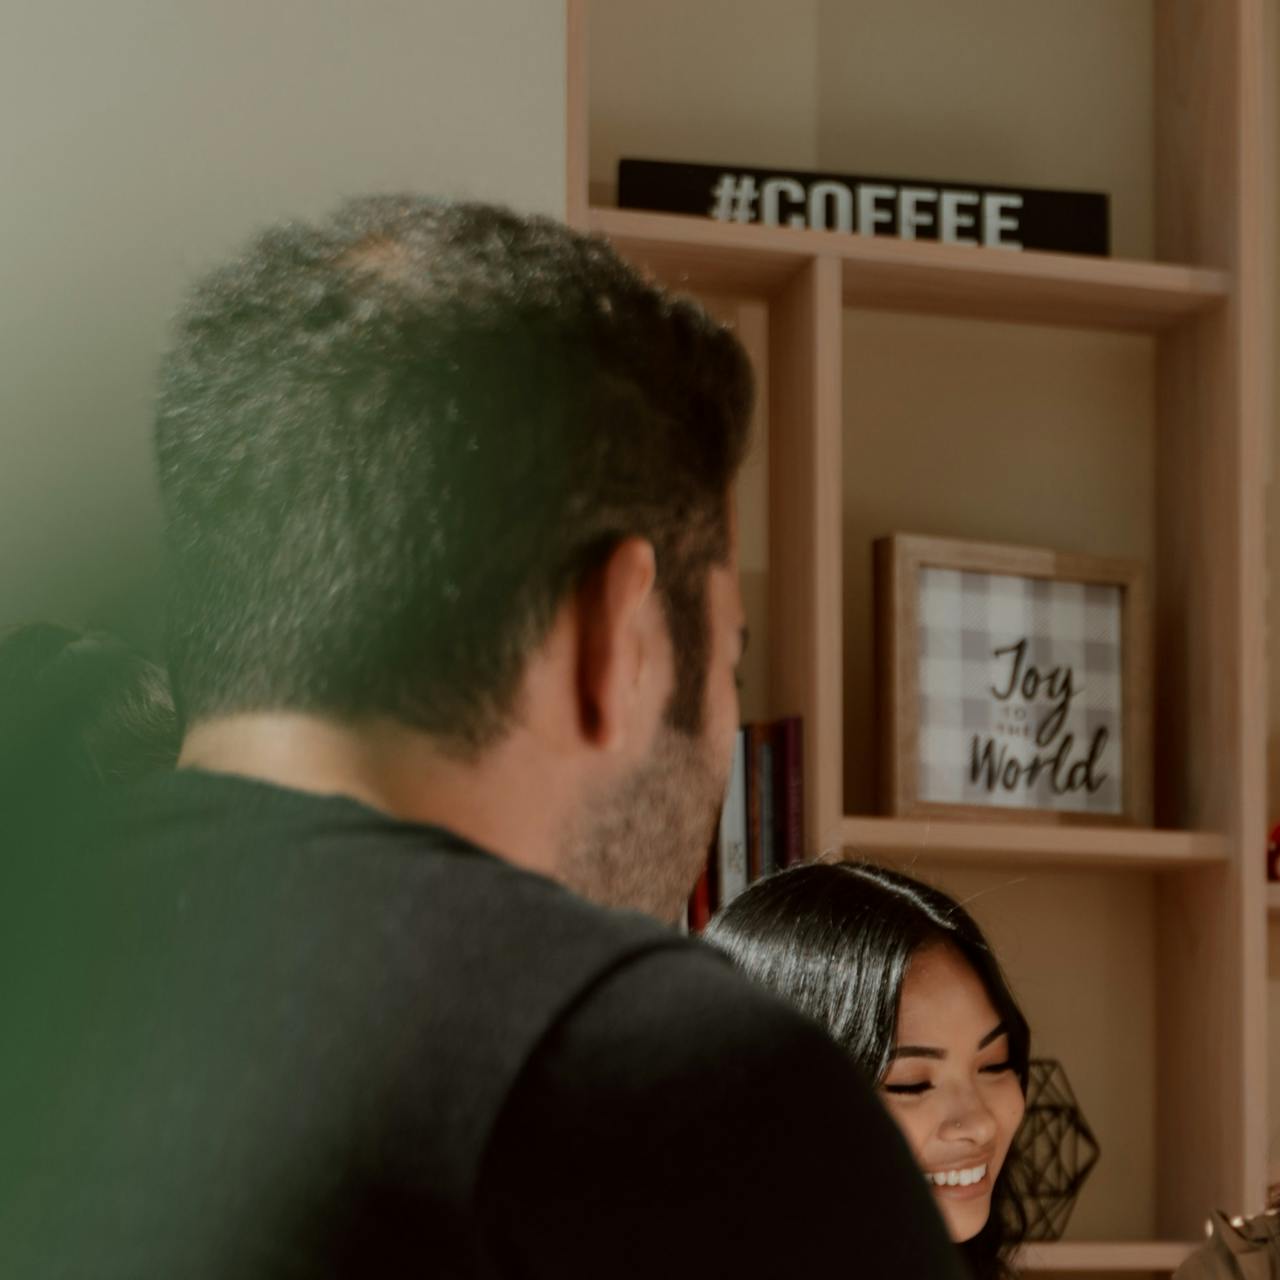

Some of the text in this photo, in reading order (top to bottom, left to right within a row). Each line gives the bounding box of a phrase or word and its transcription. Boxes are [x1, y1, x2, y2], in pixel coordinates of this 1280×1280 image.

[712, 174, 1023, 250] #COFFEE
[990, 638, 1084, 747] Joy
[968, 726, 1109, 795] World
